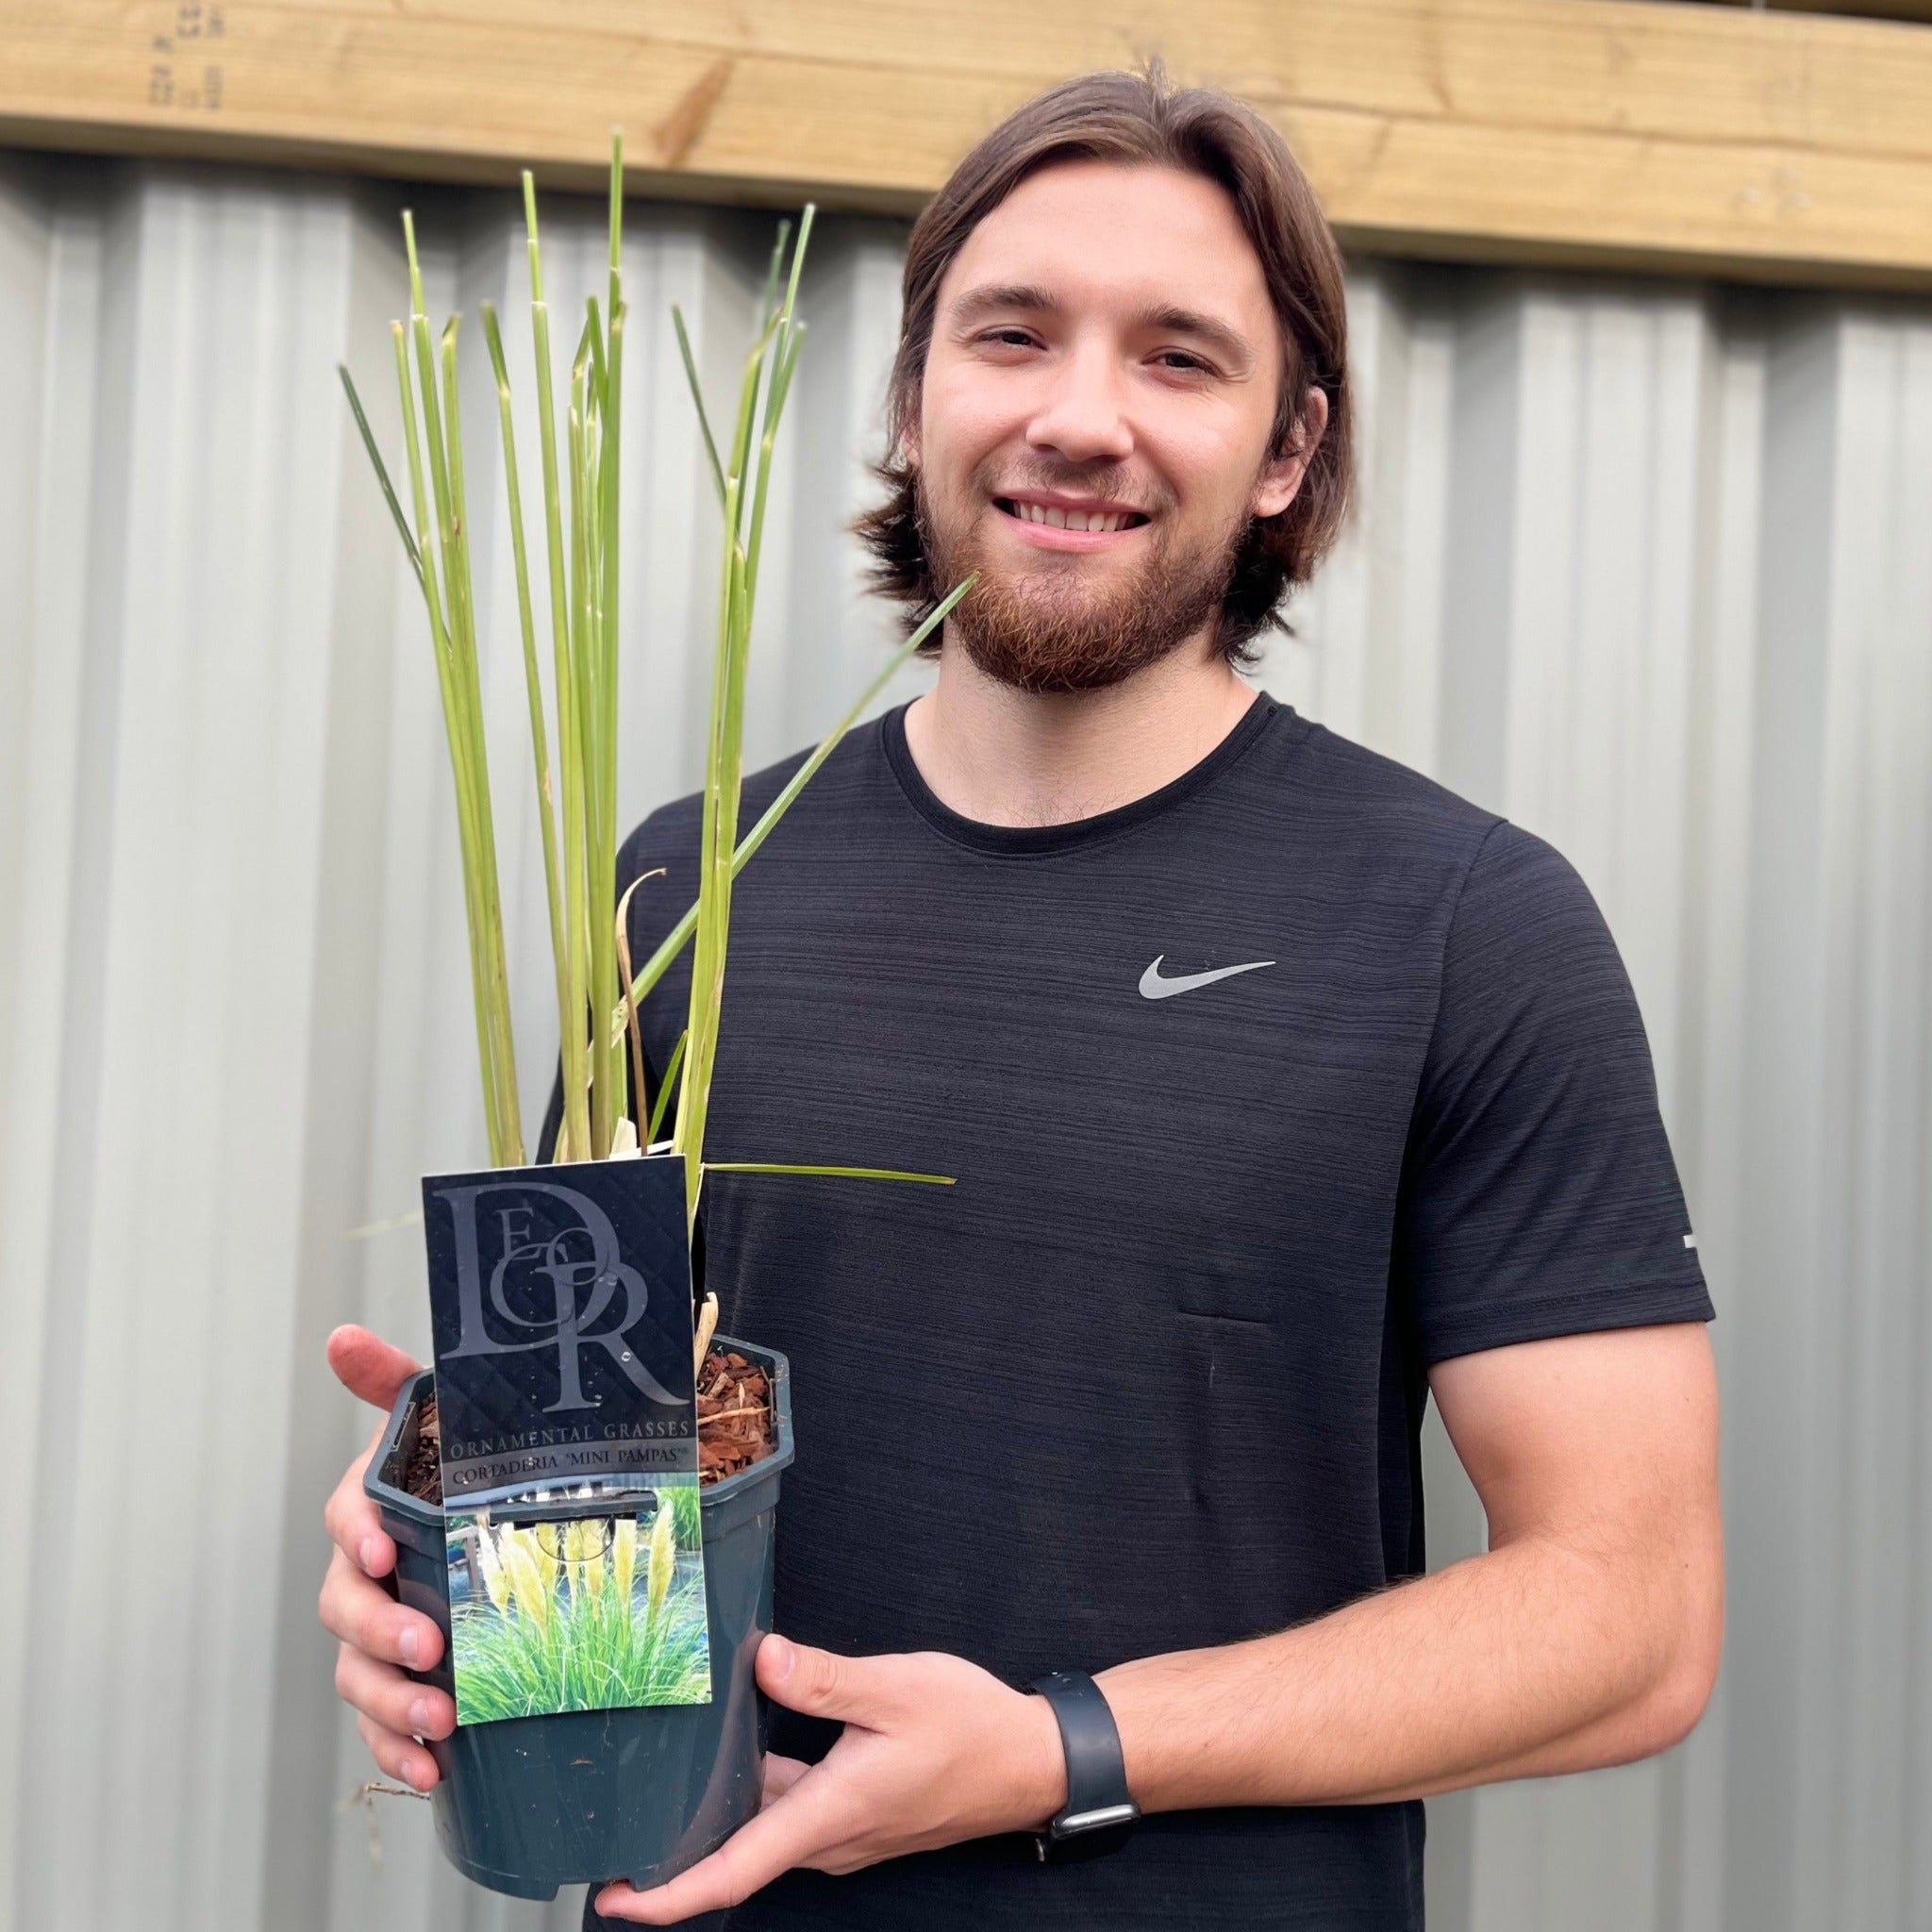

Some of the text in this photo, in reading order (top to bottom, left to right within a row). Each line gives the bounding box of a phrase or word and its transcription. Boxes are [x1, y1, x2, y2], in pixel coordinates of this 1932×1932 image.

[450, 1421, 689, 1458] ORNAMENTAL GRASSES
[453, 1455, 558, 1485] CORTADERIA
